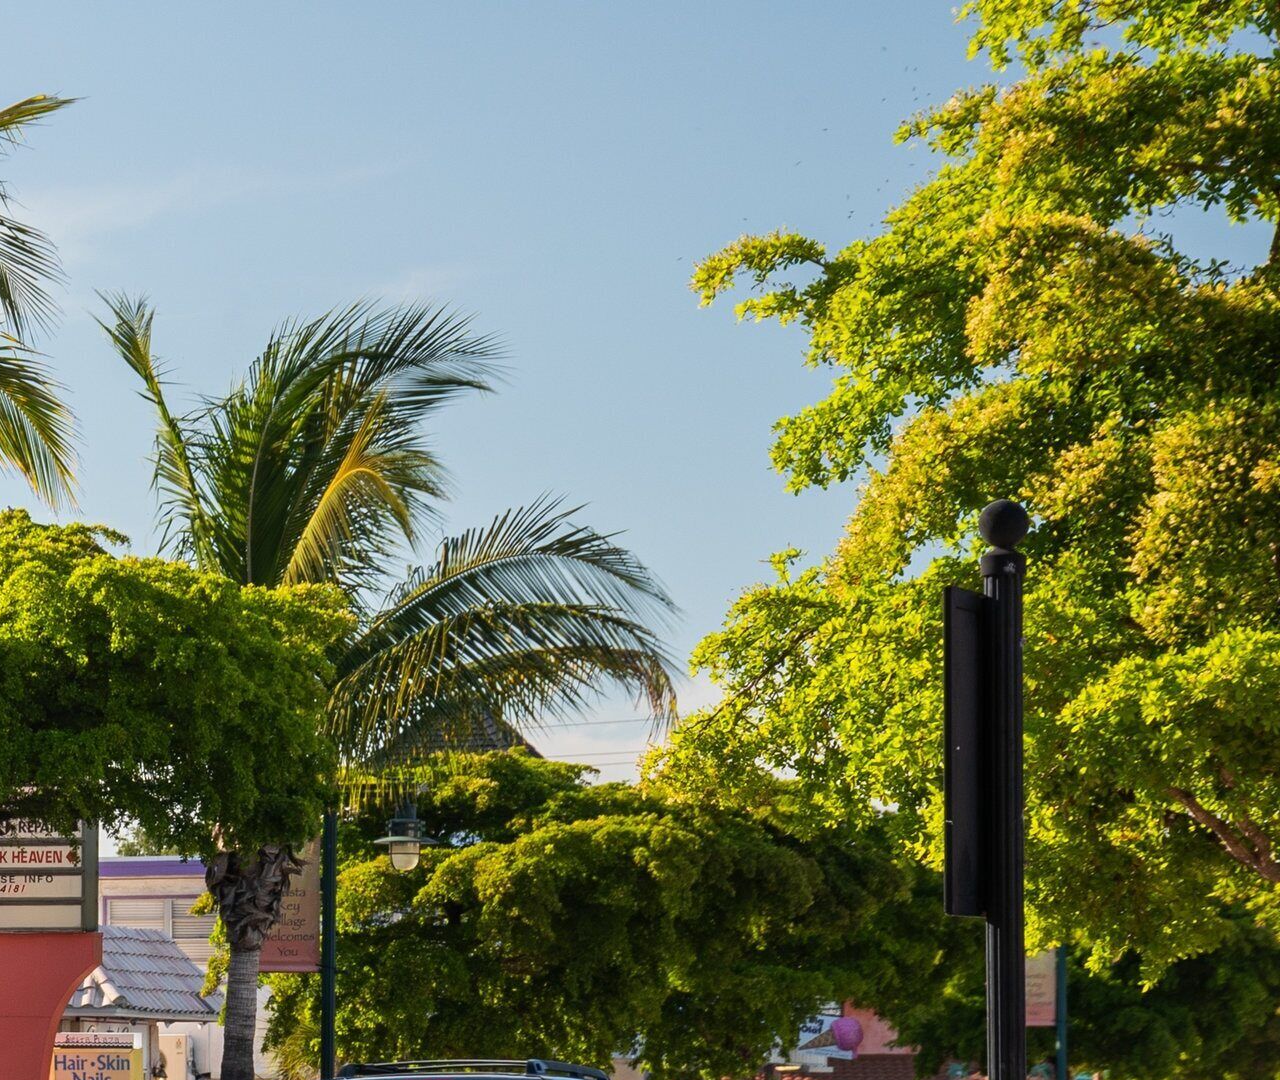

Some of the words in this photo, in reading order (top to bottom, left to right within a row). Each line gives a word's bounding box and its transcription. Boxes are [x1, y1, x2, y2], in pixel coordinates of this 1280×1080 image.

[12, 851, 63, 864] HEAVEN
[24, 875, 54, 884] INFO
[277, 947, 298, 956] You
[54, 1055, 88, 1071] Hair
[96, 1055, 130, 1071] Skin
